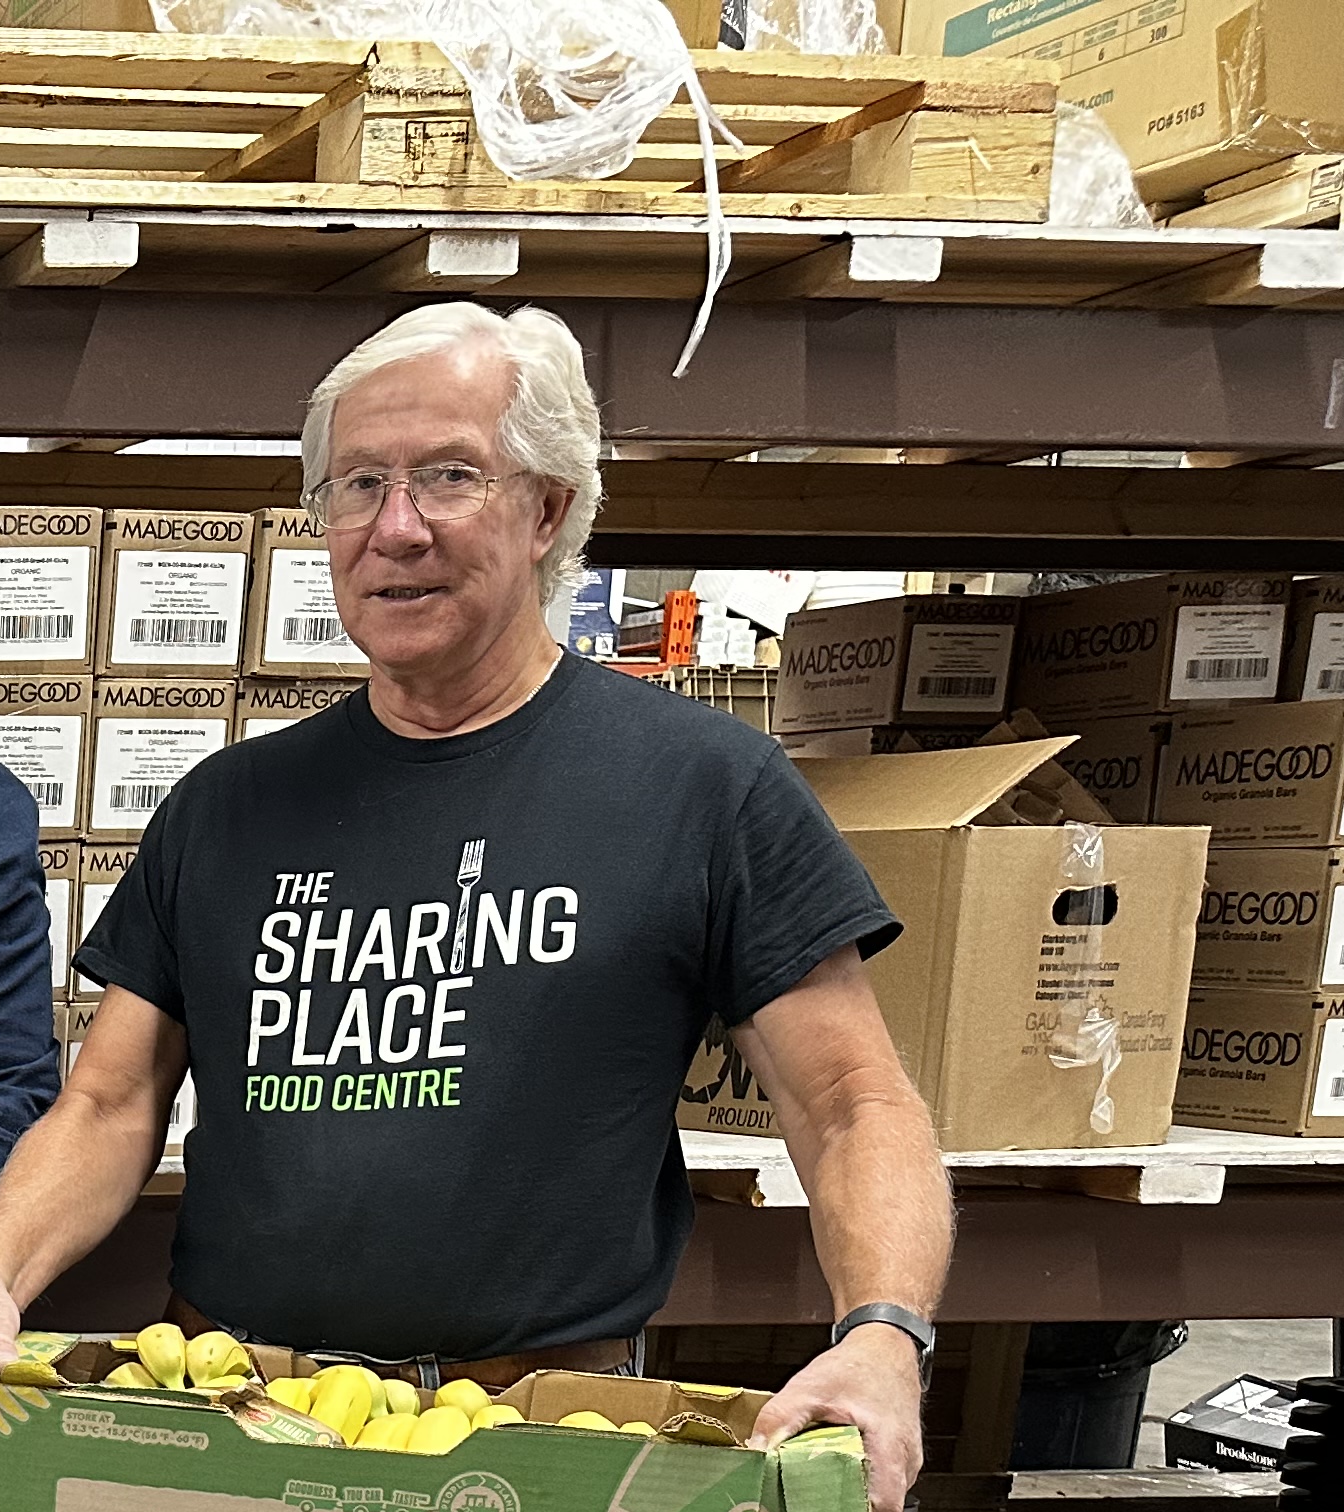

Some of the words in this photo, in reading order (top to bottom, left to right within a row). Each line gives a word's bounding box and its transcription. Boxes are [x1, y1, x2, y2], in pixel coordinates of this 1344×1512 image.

[1147, 117, 1173, 135] PO#
[1176, 102, 1206, 124] 5163
[123, 519, 243, 542] MADEGOOD
[1182, 579, 1286, 599] MADEGOOD
[1022, 618, 1158, 662] MADEGOOD
[786, 636, 897, 677] MADEGOOD
[104, 686, 226, 708] MADEGOOD
[1176, 744, 1333, 786] MADEGOOD
[1202, 791, 1236, 803] Organic
[276, 872, 334, 904] THE
[254, 865, 578, 983] SHARING
[247, 976, 473, 1066] PLACE
[1209, 1067, 1243, 1080] Granola
[1246, 1069, 1265, 1081] Bars
[246, 1075, 323, 1112] FOOD
[332, 1067, 463, 1111] CENTRE
[707, 1107, 775, 1129] PROUDLY
[66, 1412, 97, 1422] STORE
[98, 1415, 111, 1423] AT
[66, 1424, 87, 1433] 13.3
[107, 1427, 127, 1437] 15.6
[1216, 1441, 1277, 1467] Brookstone
[345, 1489, 362, 1501] YOU
[364, 1489, 381, 1501] CAN
